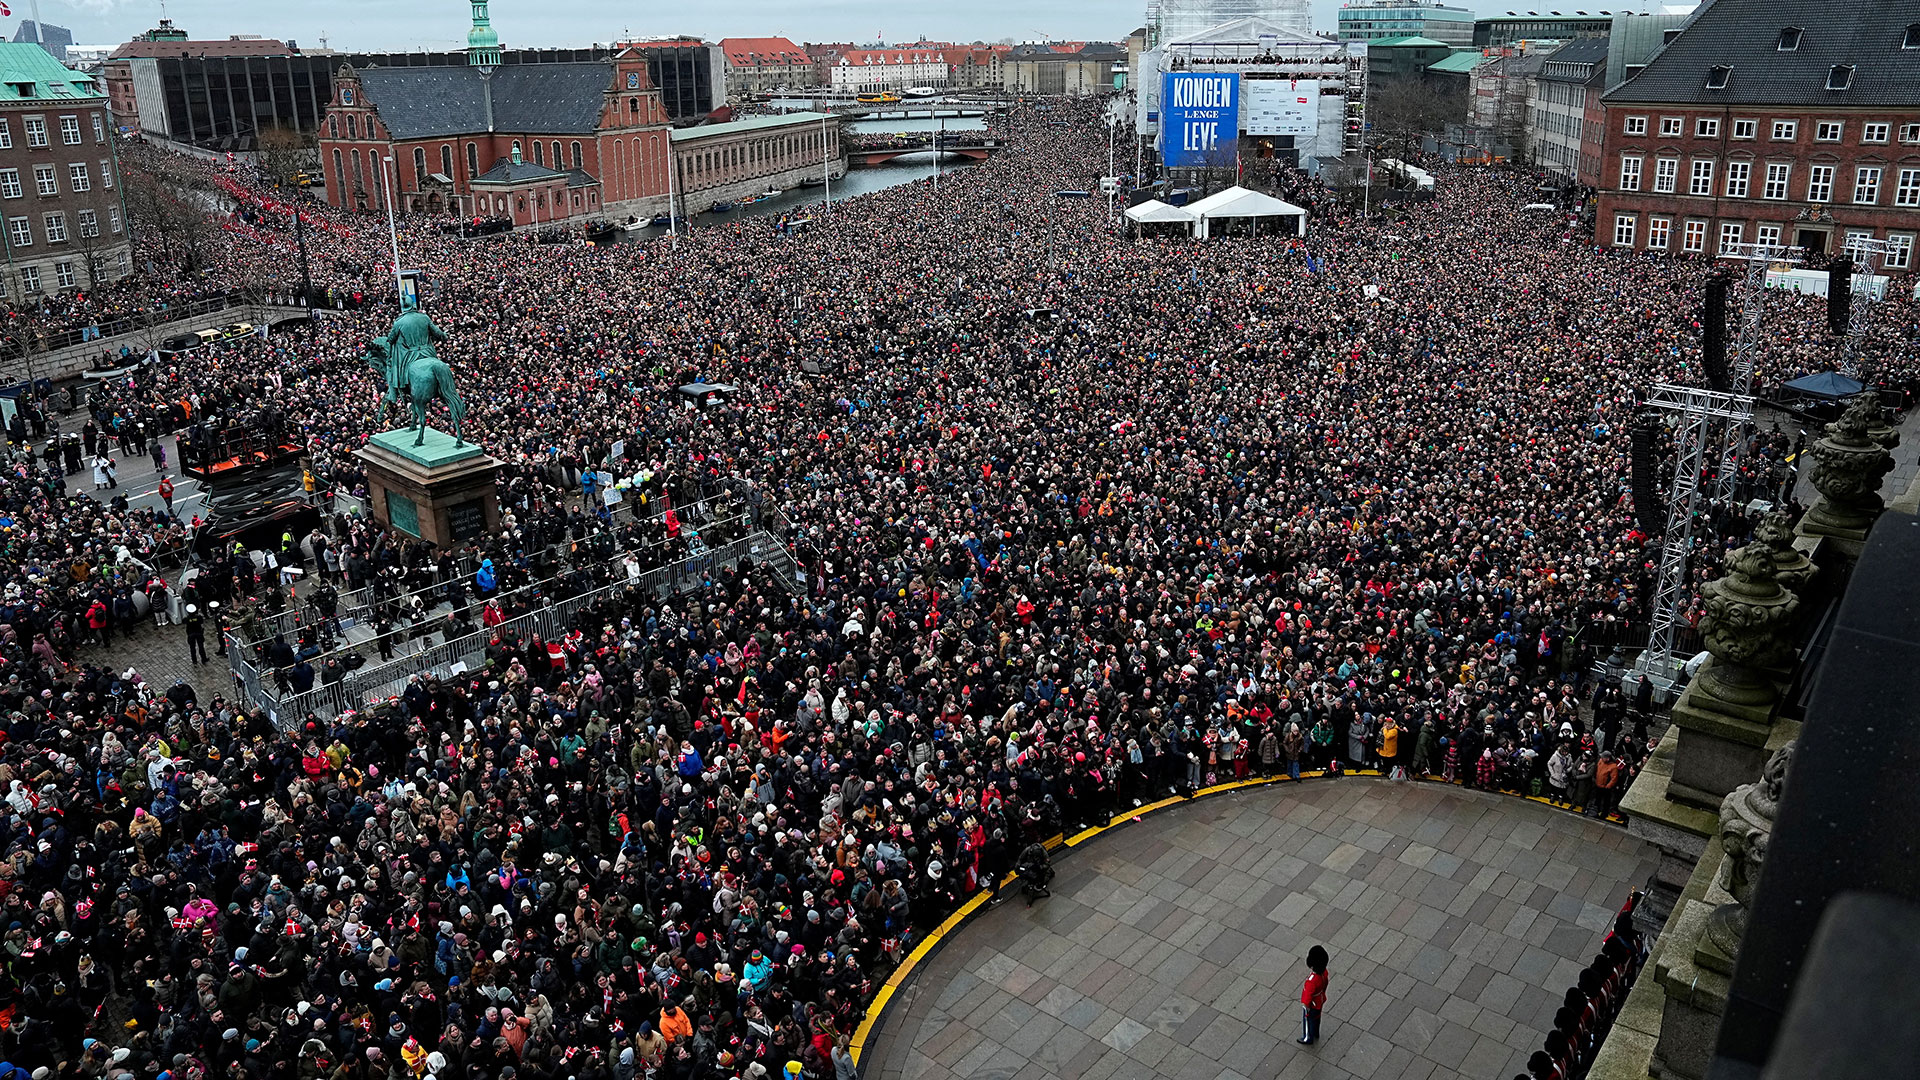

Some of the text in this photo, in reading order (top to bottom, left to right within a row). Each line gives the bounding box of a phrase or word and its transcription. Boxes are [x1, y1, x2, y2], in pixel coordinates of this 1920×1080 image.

[1174, 78, 1231, 107] KONGEN
[1184, 110, 1219, 118] LÆNGE
[1184, 122, 1218, 150] LEVE
